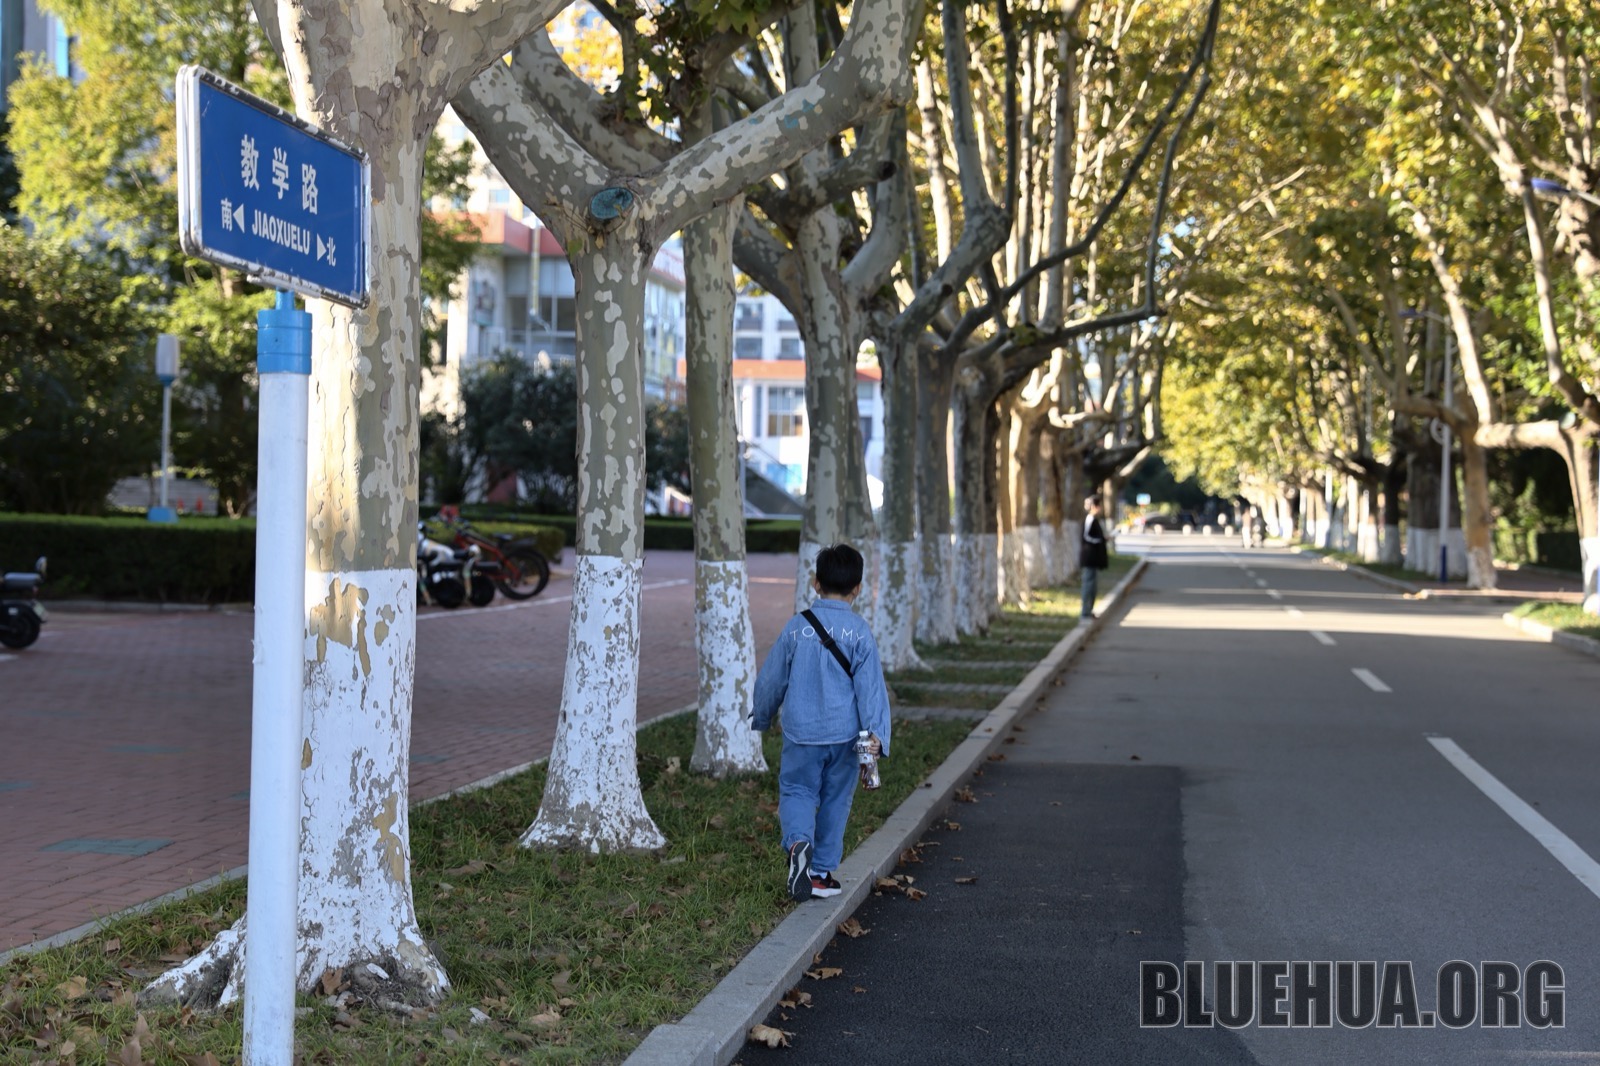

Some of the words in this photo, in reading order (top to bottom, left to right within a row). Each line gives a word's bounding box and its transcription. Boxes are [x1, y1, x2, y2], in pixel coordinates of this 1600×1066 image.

[240, 133, 318, 215] 教学路
[220, 197, 232, 231] 南
[251, 209, 310, 255] JIAOXUELU
[326, 236, 336, 267] 北
[789, 626, 864, 643] TOMMY
